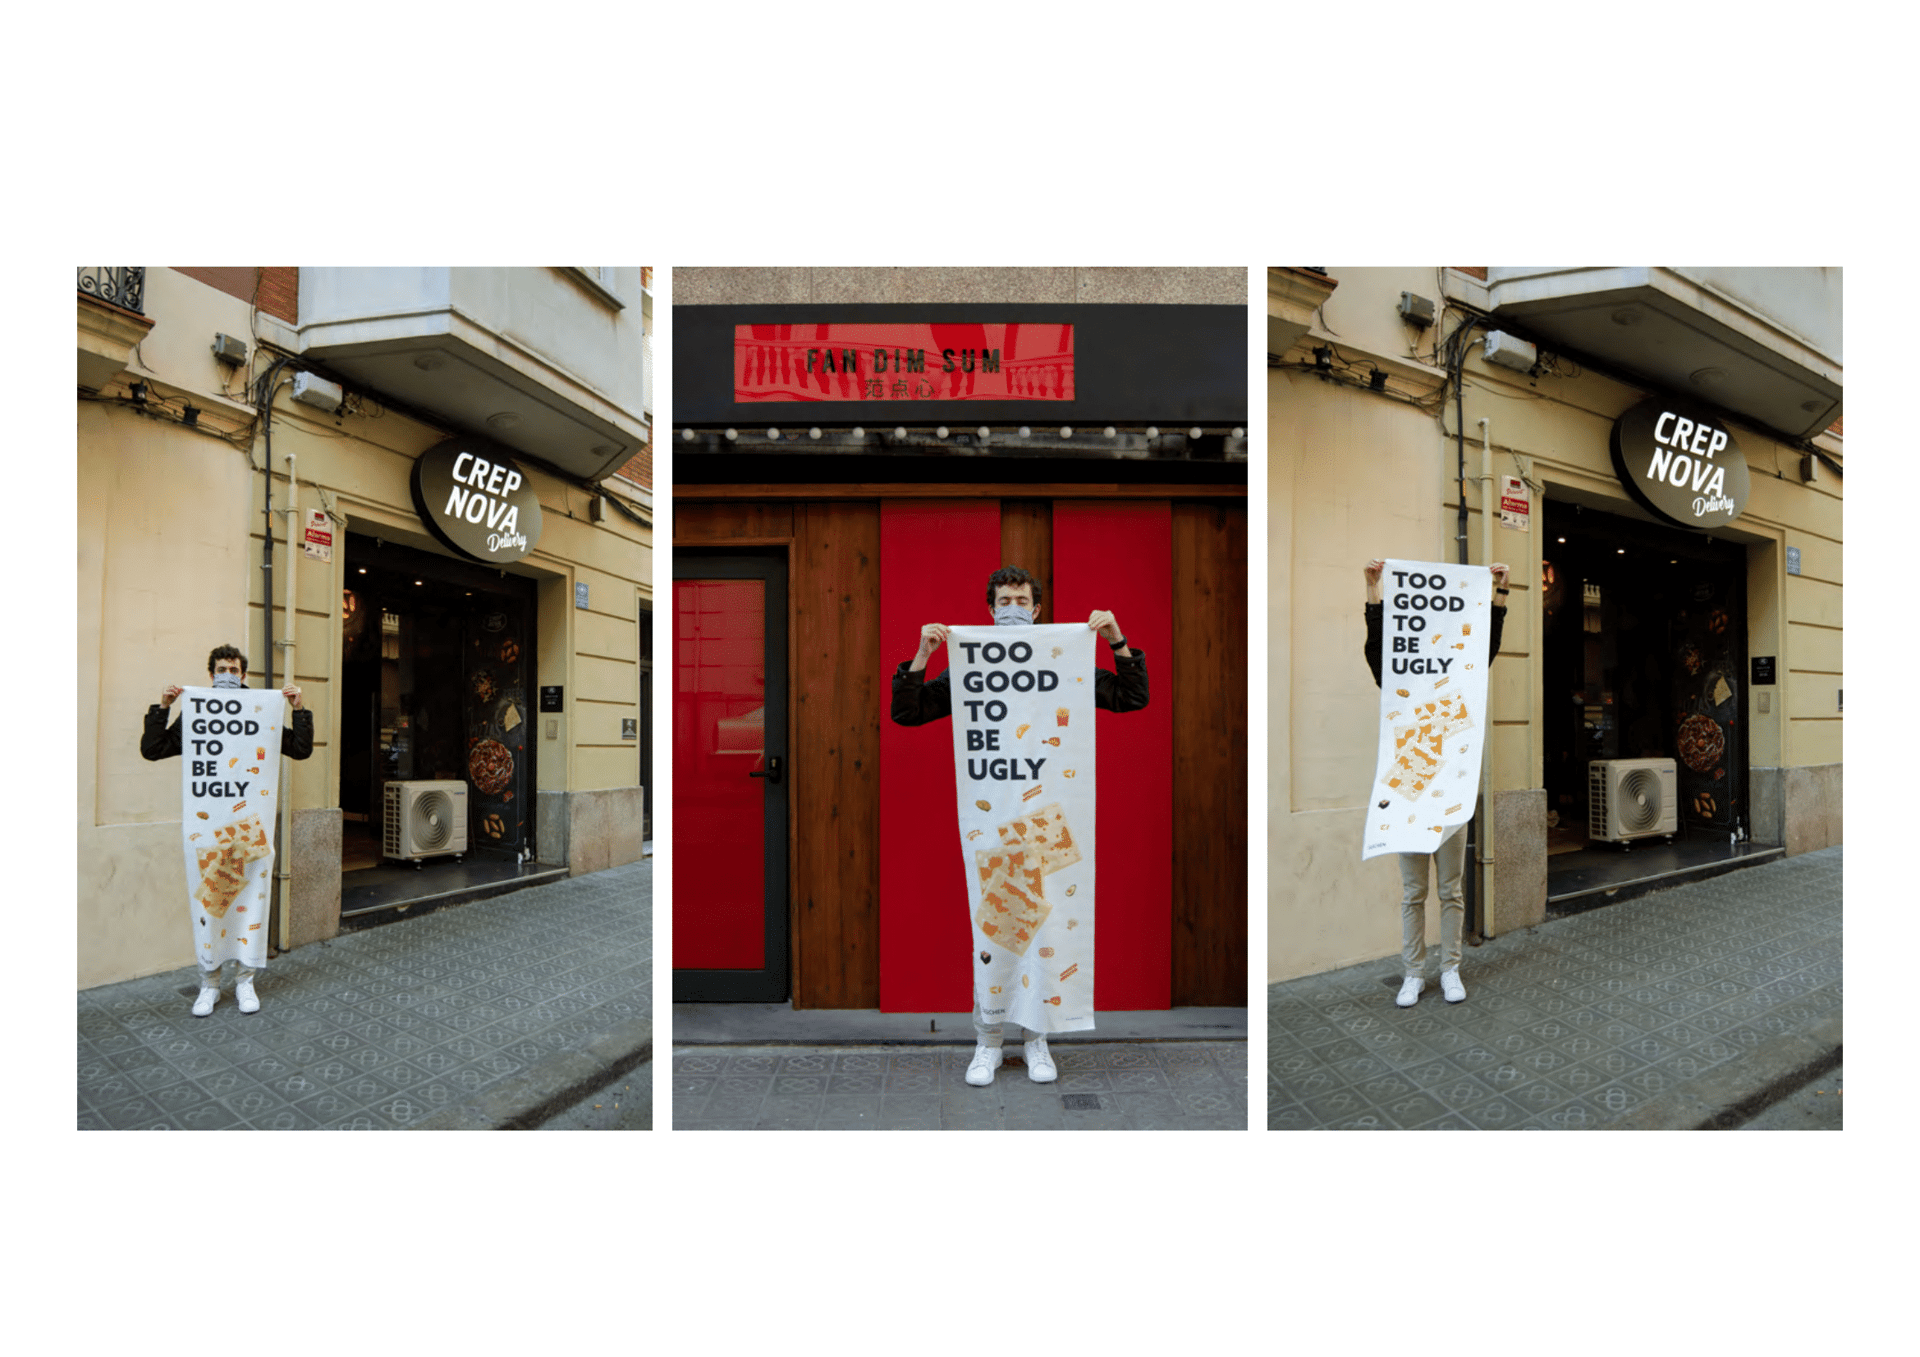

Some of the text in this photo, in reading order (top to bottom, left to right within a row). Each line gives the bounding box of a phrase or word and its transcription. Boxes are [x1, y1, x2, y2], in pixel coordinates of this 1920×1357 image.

[807, 348, 1000, 374] FAN DIM SUM
[865, 378, 935, 398] 范点心
[1653, 411, 1728, 459] CREP
[452, 451, 522, 498] CREP
[1646, 446, 1725, 499] NOVA
[444, 485, 519, 535] NOVA
[1692, 494, 1735, 517] Delivery
[486, 531, 527, 553] Delivery
[1392, 572, 1446, 590] TOO
[1393, 594, 1465, 612] GOOD
[1393, 615, 1426, 632] TO
[960, 642, 1033, 664] TOO
[1393, 637, 1420, 654] BE
[1392, 658, 1453, 675] UGLY
[963, 669, 1059, 693] GOOD
[191, 698, 242, 715] TOO
[964, 700, 1008, 722] TO
[191, 718, 259, 736] GOOD
[191, 740, 224, 756] TO
[967, 730, 1000, 752] BE
[192, 760, 217, 777] BE
[967, 759, 1047, 781] UGLY
[192, 781, 250, 798] UGLY
